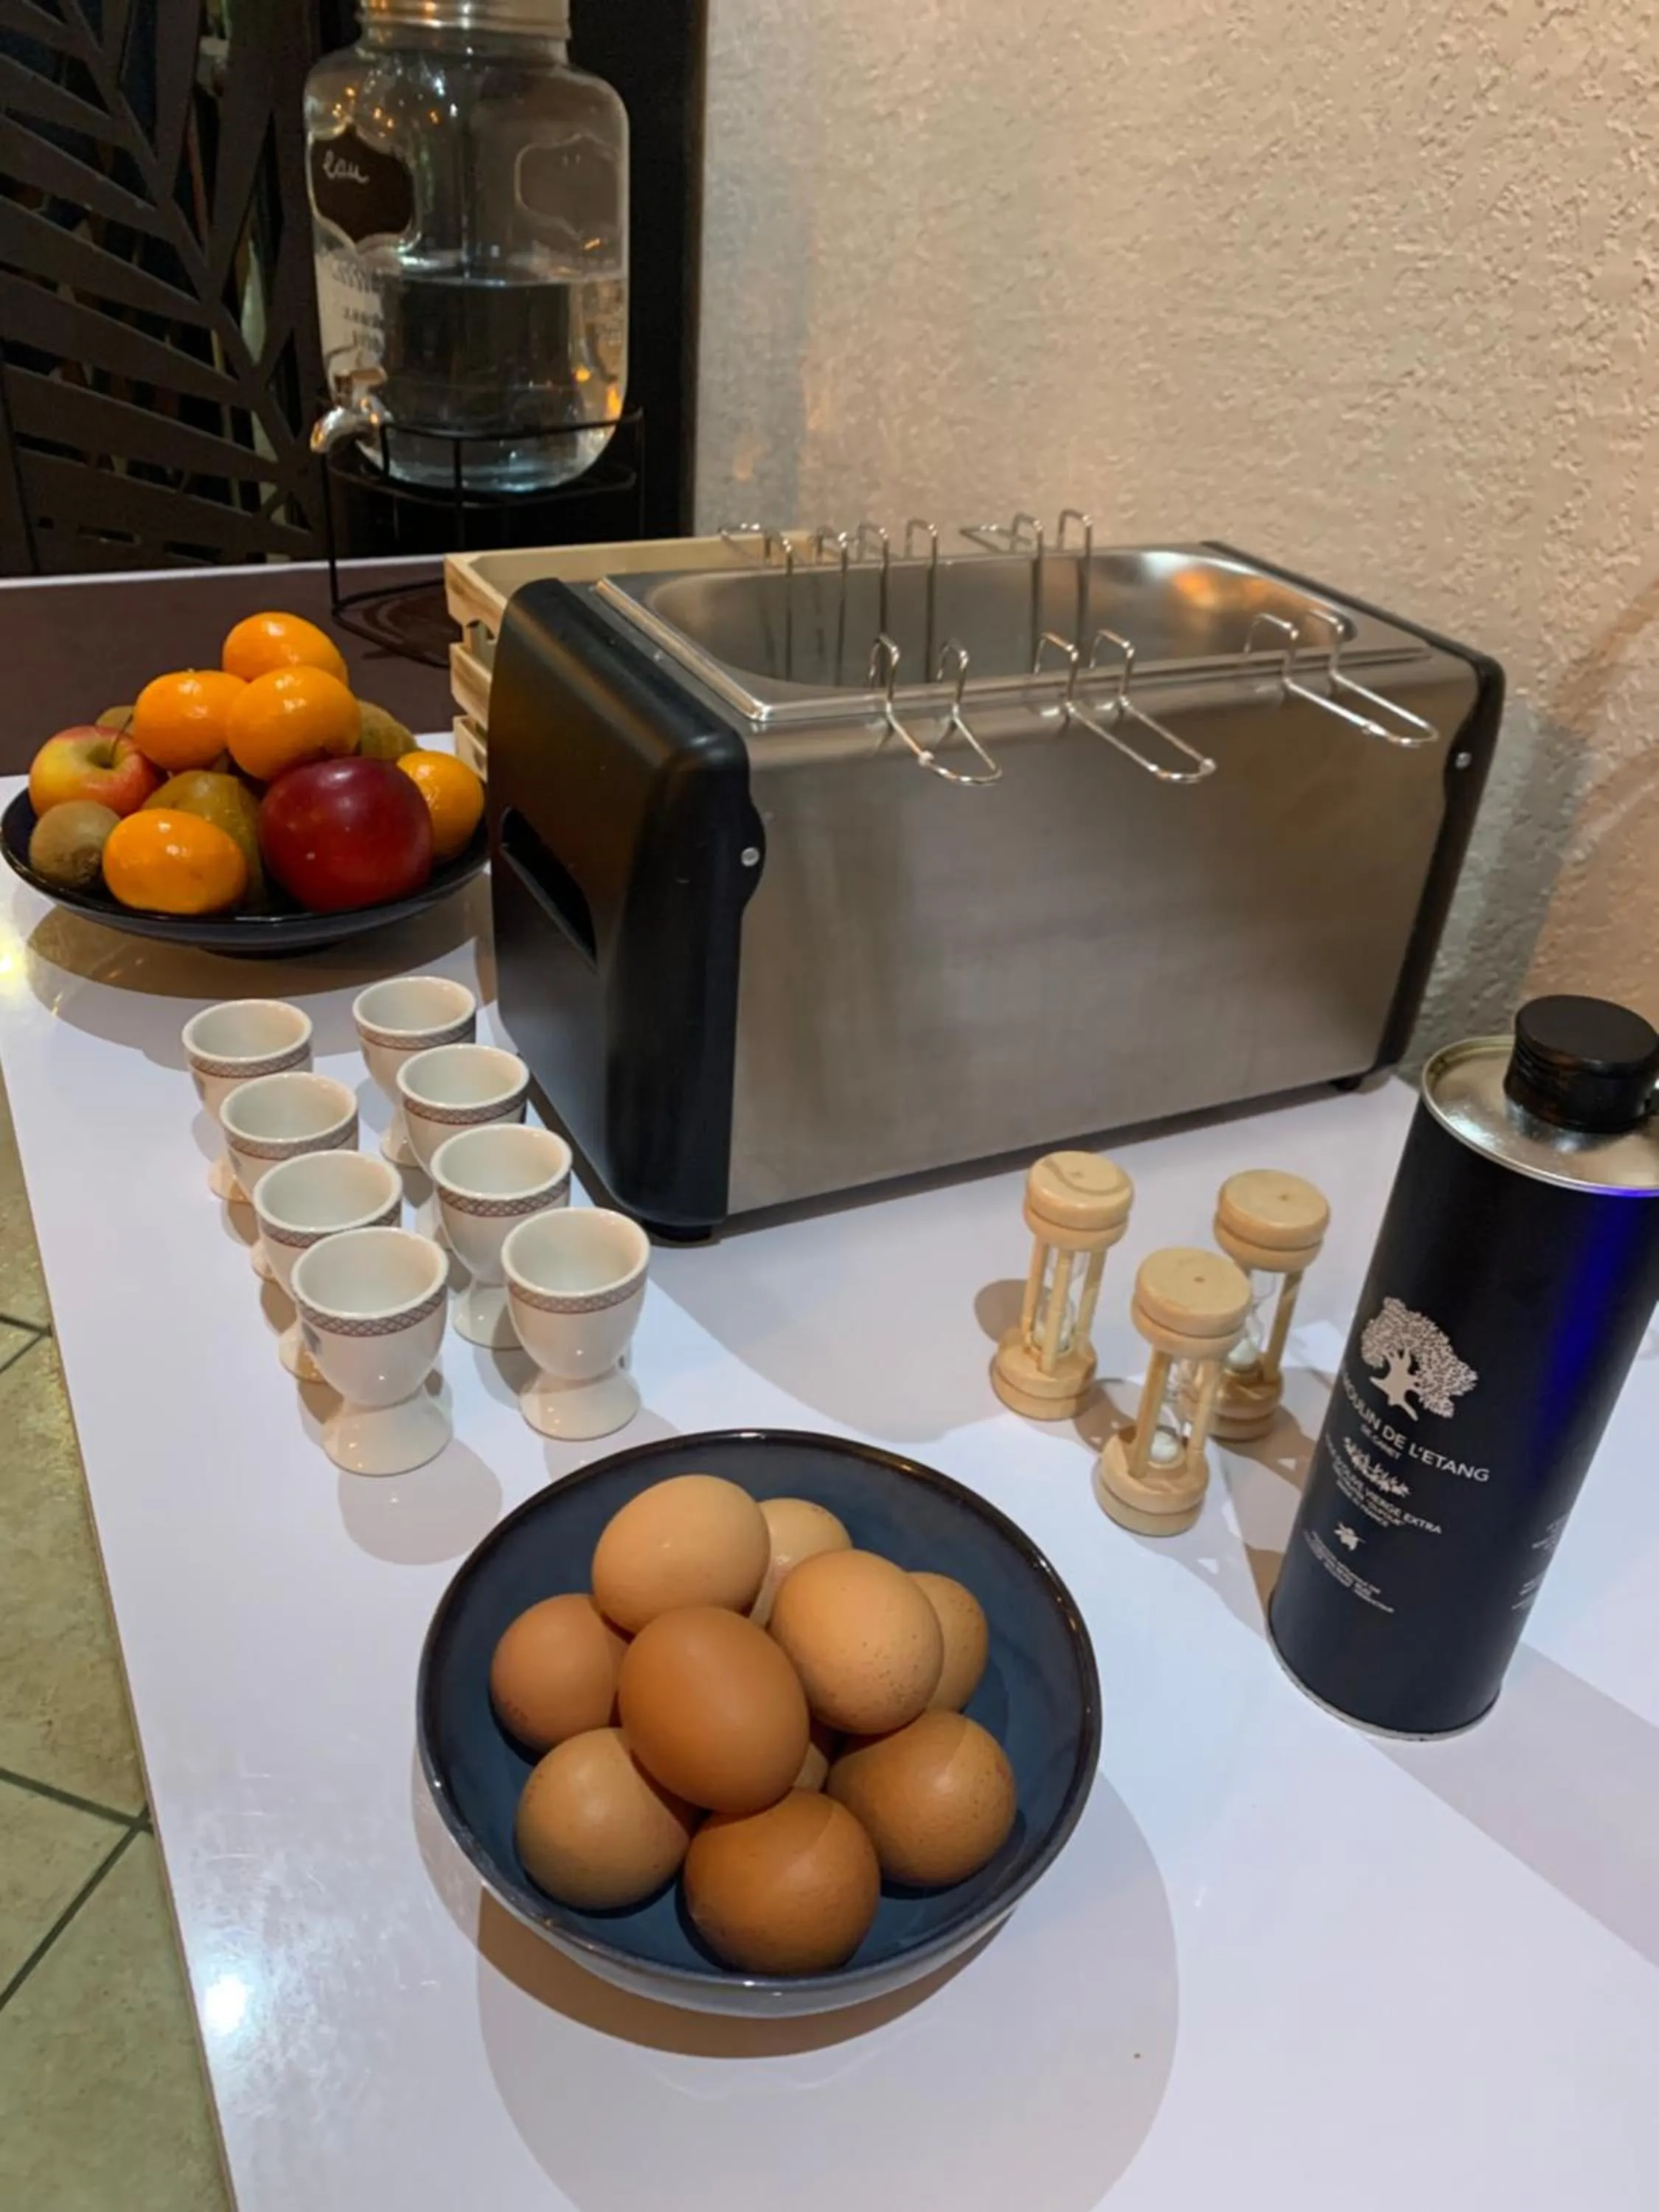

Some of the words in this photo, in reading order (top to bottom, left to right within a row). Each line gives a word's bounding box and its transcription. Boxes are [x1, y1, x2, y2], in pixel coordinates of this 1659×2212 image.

[1383, 1425, 1407, 1449] DE
[1408, 1442, 1491, 1482] L'ETANG
[1403, 1512, 1442, 1534] EXTRA
